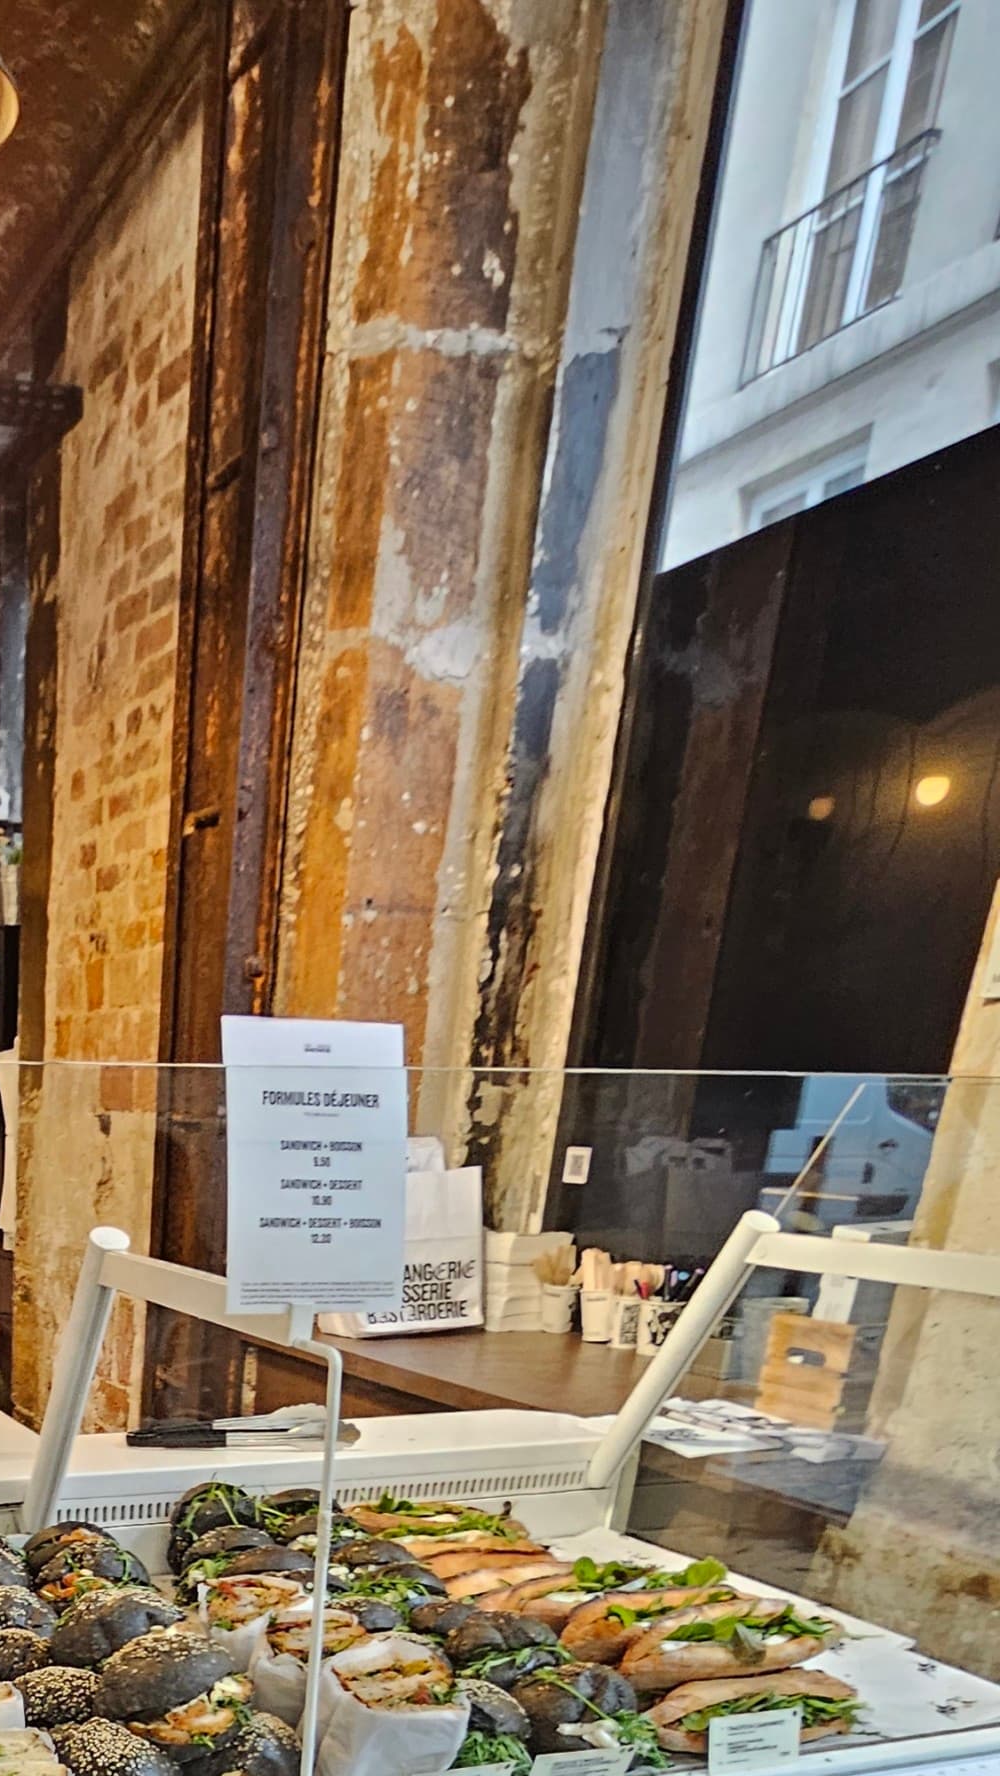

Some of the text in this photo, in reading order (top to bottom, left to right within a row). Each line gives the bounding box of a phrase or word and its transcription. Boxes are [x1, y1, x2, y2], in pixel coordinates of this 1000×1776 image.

[262, 1089, 380, 1109] FORMULES DÉJEUNER
[280, 1140, 322, 1151] SANDWICH
[280, 1179, 322, 1190] SANDWICH
[259, 1217, 301, 1229] SANDWICH
[402, 1259, 477, 1284] ANGERIE
[401, 1281, 453, 1304] SSERIE
